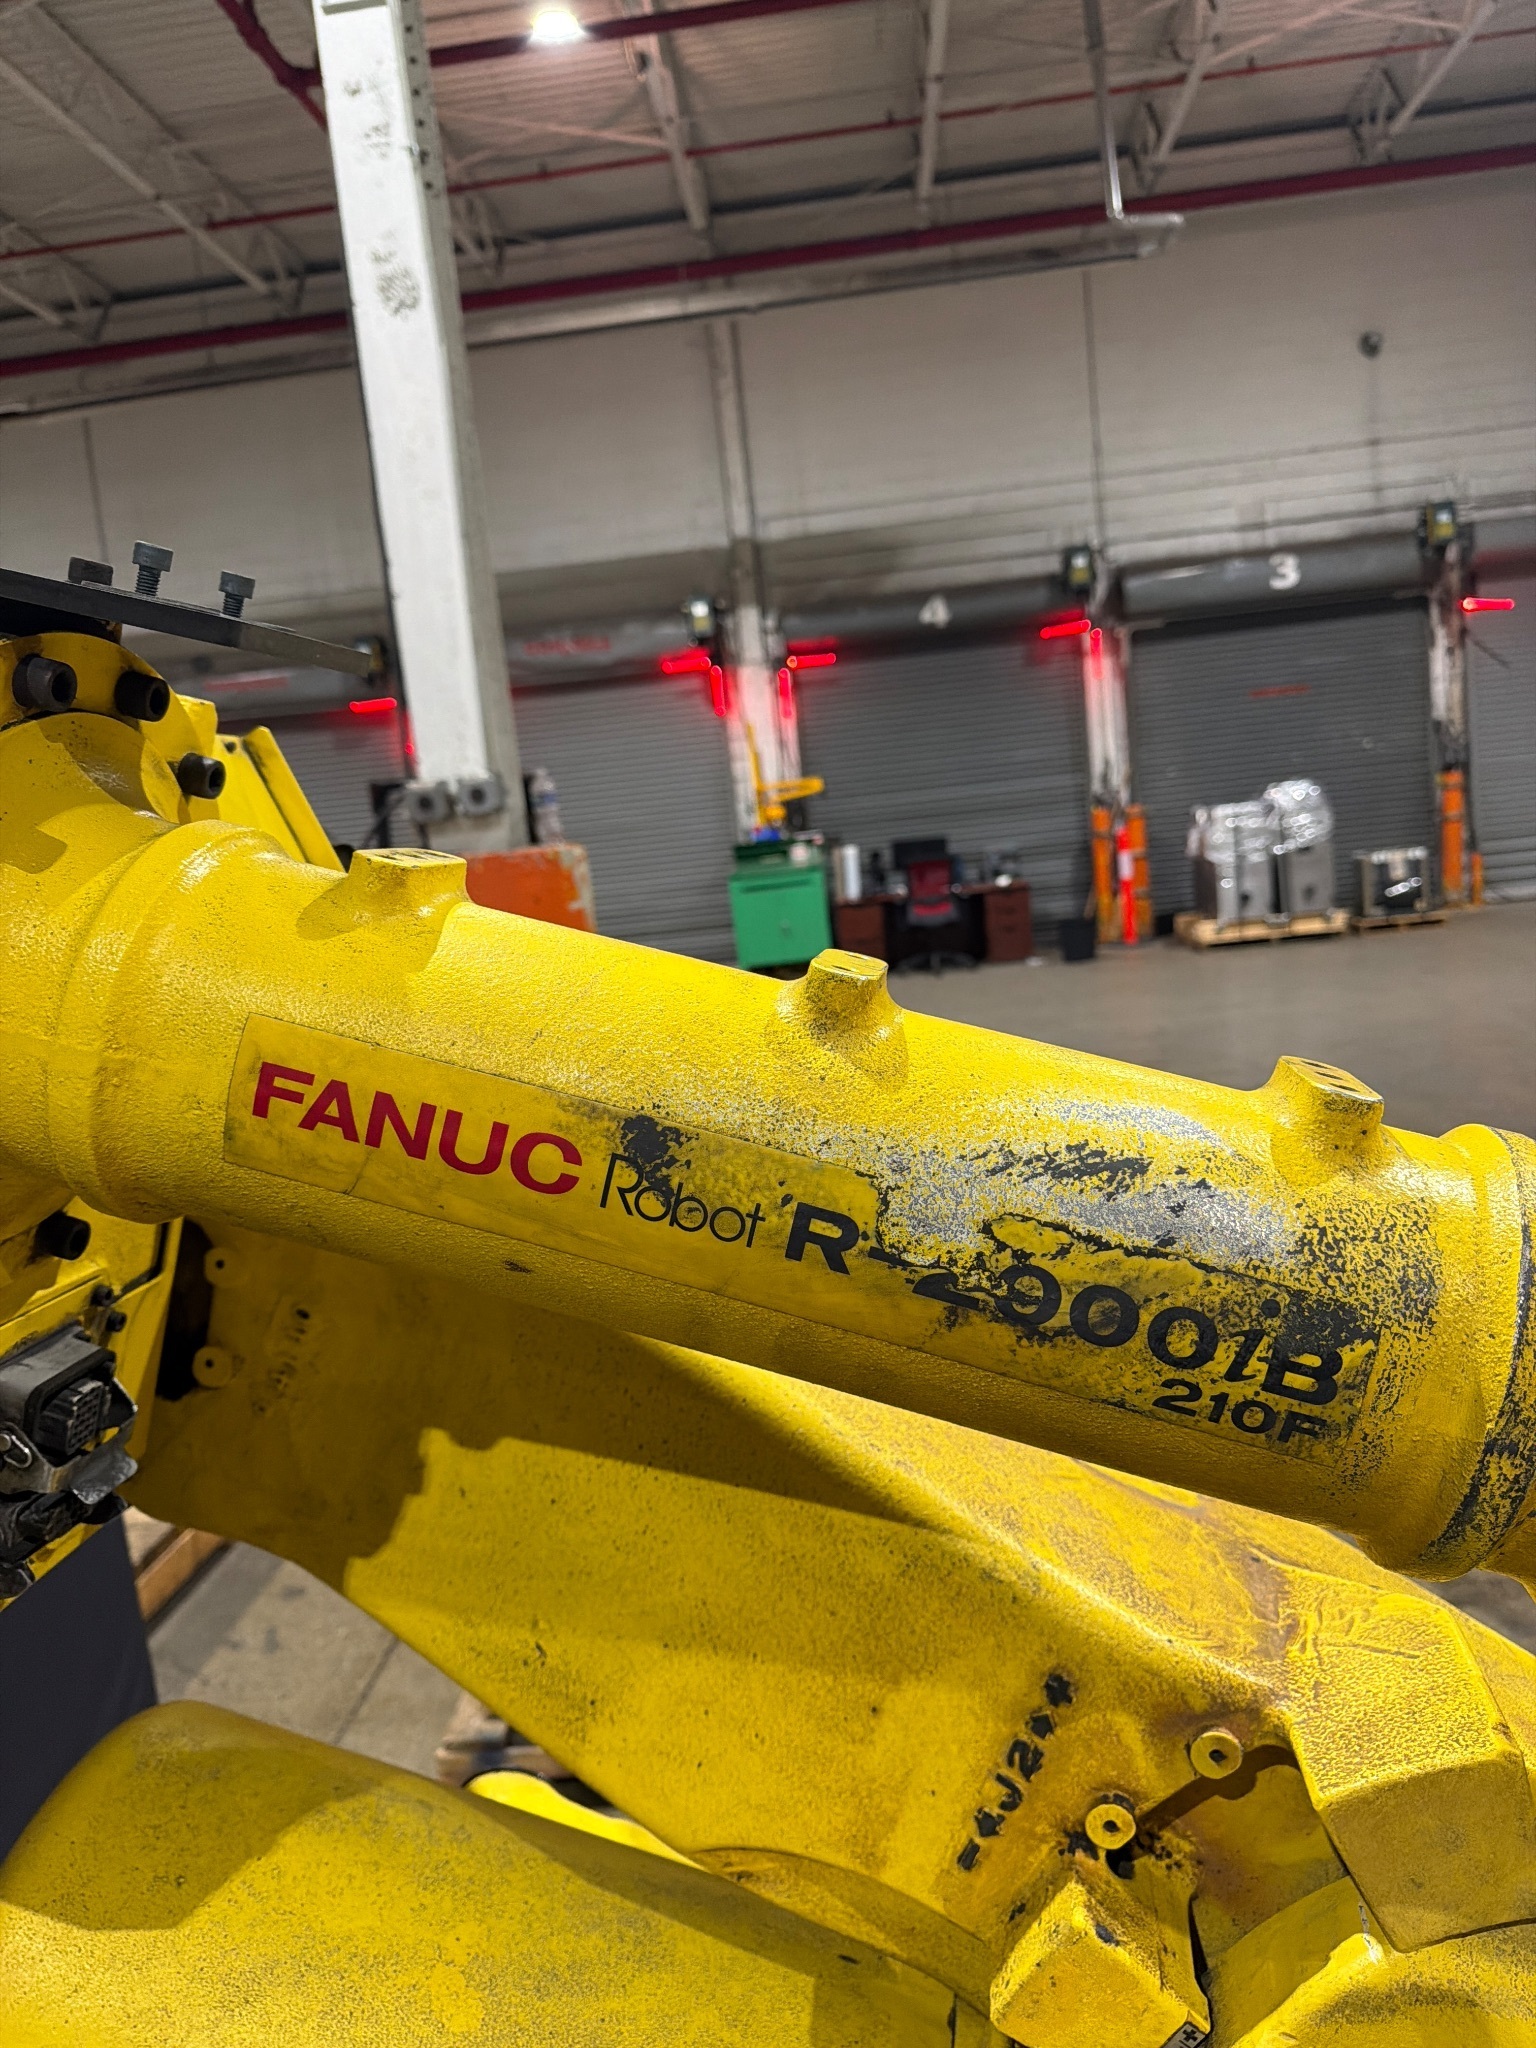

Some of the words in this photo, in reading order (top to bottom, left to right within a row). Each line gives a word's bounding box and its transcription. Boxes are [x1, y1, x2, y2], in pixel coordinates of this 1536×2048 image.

[1269, 553, 1301, 590] 3
[919, 594, 951, 629] 4
[252, 1061, 583, 1195] FANUC
[600, 1152, 766, 1248] Robot
[1152, 1378, 1328, 1443] 210F
